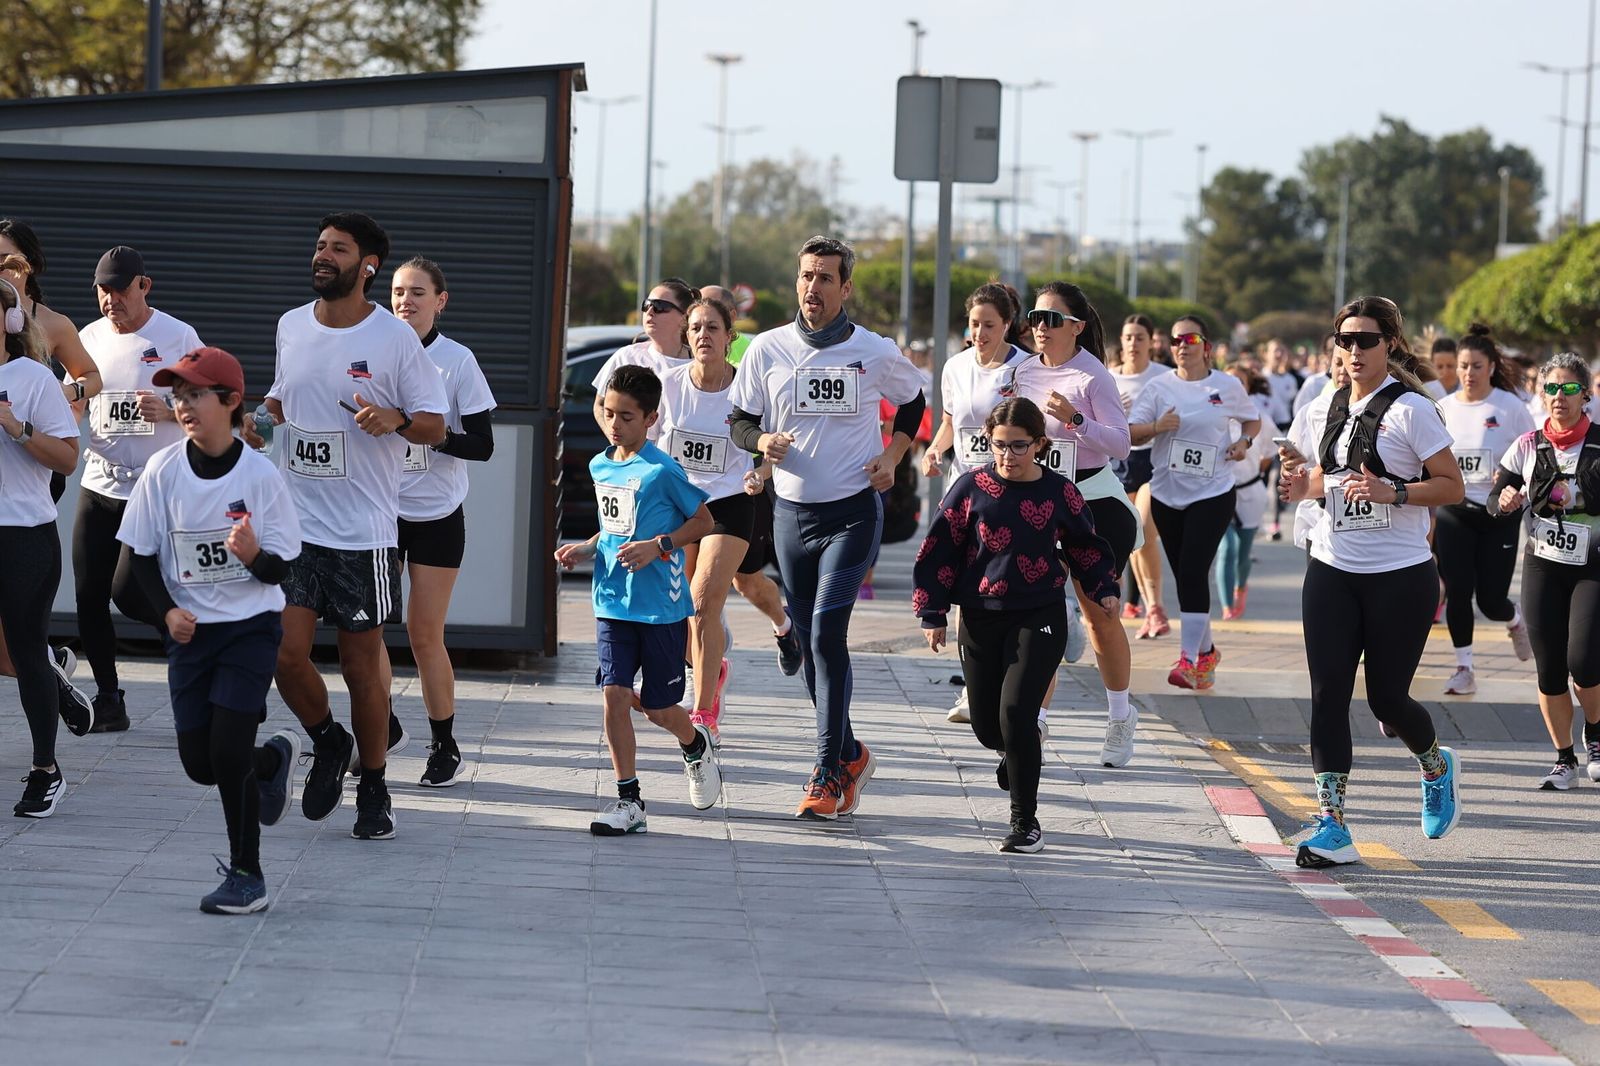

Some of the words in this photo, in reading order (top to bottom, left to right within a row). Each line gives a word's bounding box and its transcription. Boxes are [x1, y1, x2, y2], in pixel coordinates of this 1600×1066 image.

[808, 378, 845, 400] 399
[109, 401, 142, 421] 462
[295, 439, 331, 464] 443
[682, 440, 713, 461] 381
[971, 435, 989, 452] 29
[1183, 448, 1203, 466] 63
[1457, 456, 1482, 471] 467
[601, 495, 619, 518] 36
[1546, 529, 1577, 551] 359
[195, 541, 228, 568] 35
